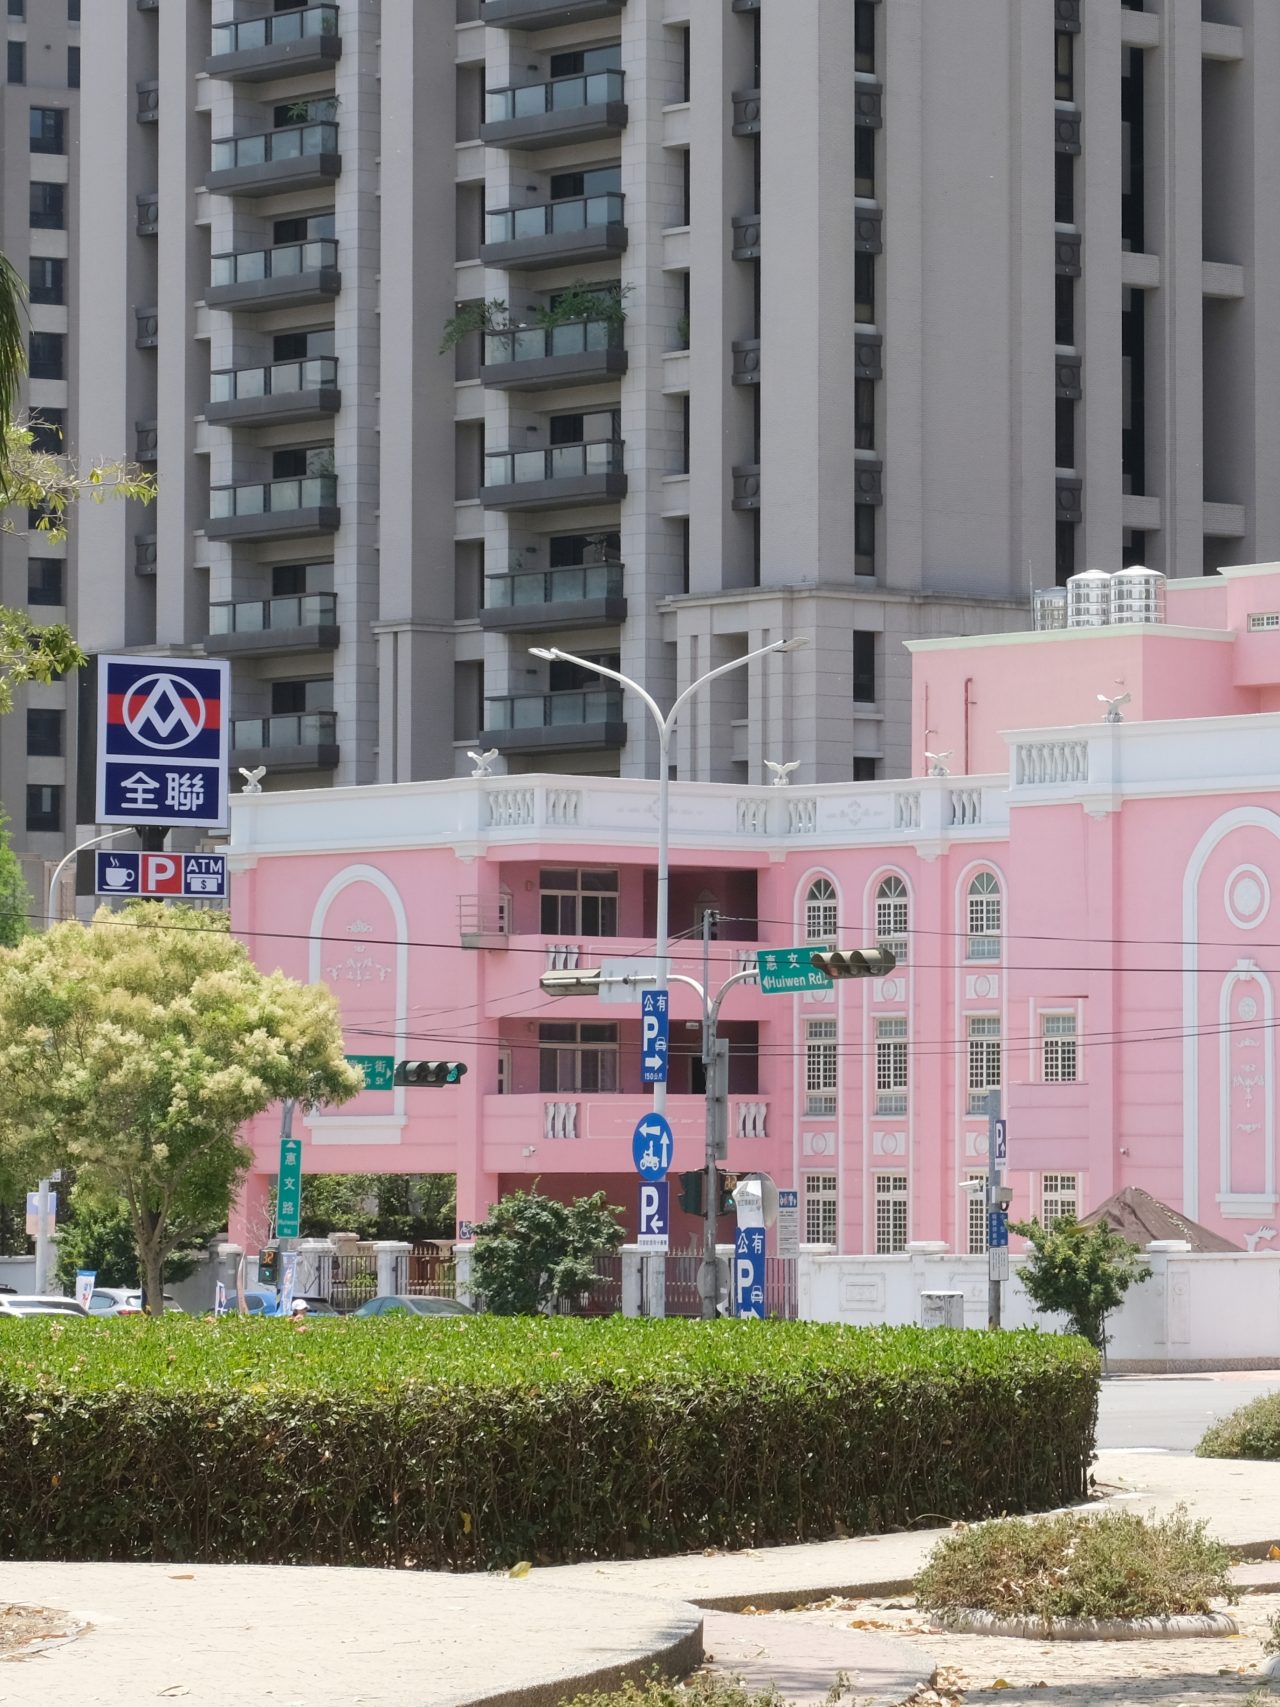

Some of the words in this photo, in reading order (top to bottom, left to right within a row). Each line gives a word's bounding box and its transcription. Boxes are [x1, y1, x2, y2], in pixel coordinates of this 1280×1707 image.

[120, 770, 204, 811] 全聯
[147, 856, 176, 891] P
[187, 859, 223, 874] ATM
[765, 951, 820, 971] 惠文
[768, 975, 806, 988] Huiwen
[644, 994, 667, 1012] 公有
[643, 1015, 659, 1052] P
[995, 1122, 1004, 1157] P
[282, 1151, 297, 1215] 惠文路
[640, 1186, 659, 1233] P
[737, 1232, 764, 1254] 公有
[736, 1258, 755, 1304] P
